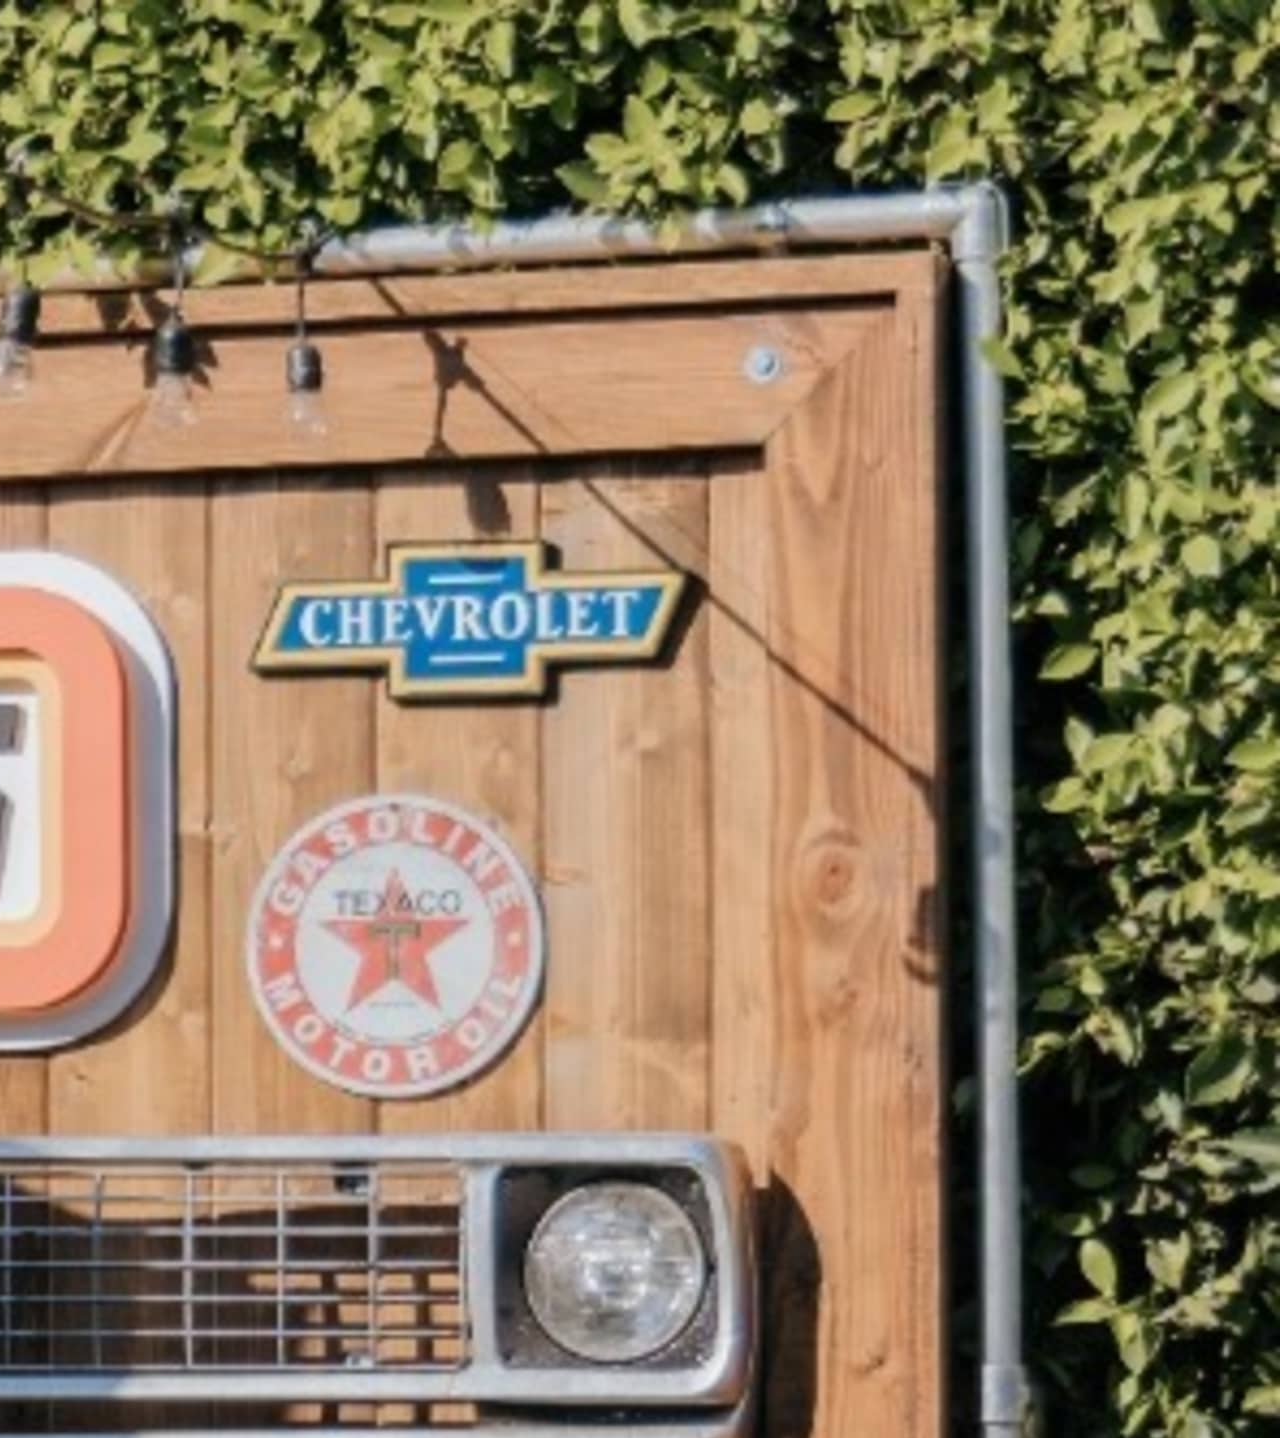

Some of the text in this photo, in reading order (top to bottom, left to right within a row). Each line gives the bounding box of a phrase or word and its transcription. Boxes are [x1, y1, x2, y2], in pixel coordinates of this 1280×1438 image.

[299, 591, 640, 647] CHEVROLET
[272, 811, 522, 915] GASOLINE
[333, 889, 462, 915] TEXACO
[265, 973, 522, 1081] MOTOR OIL
